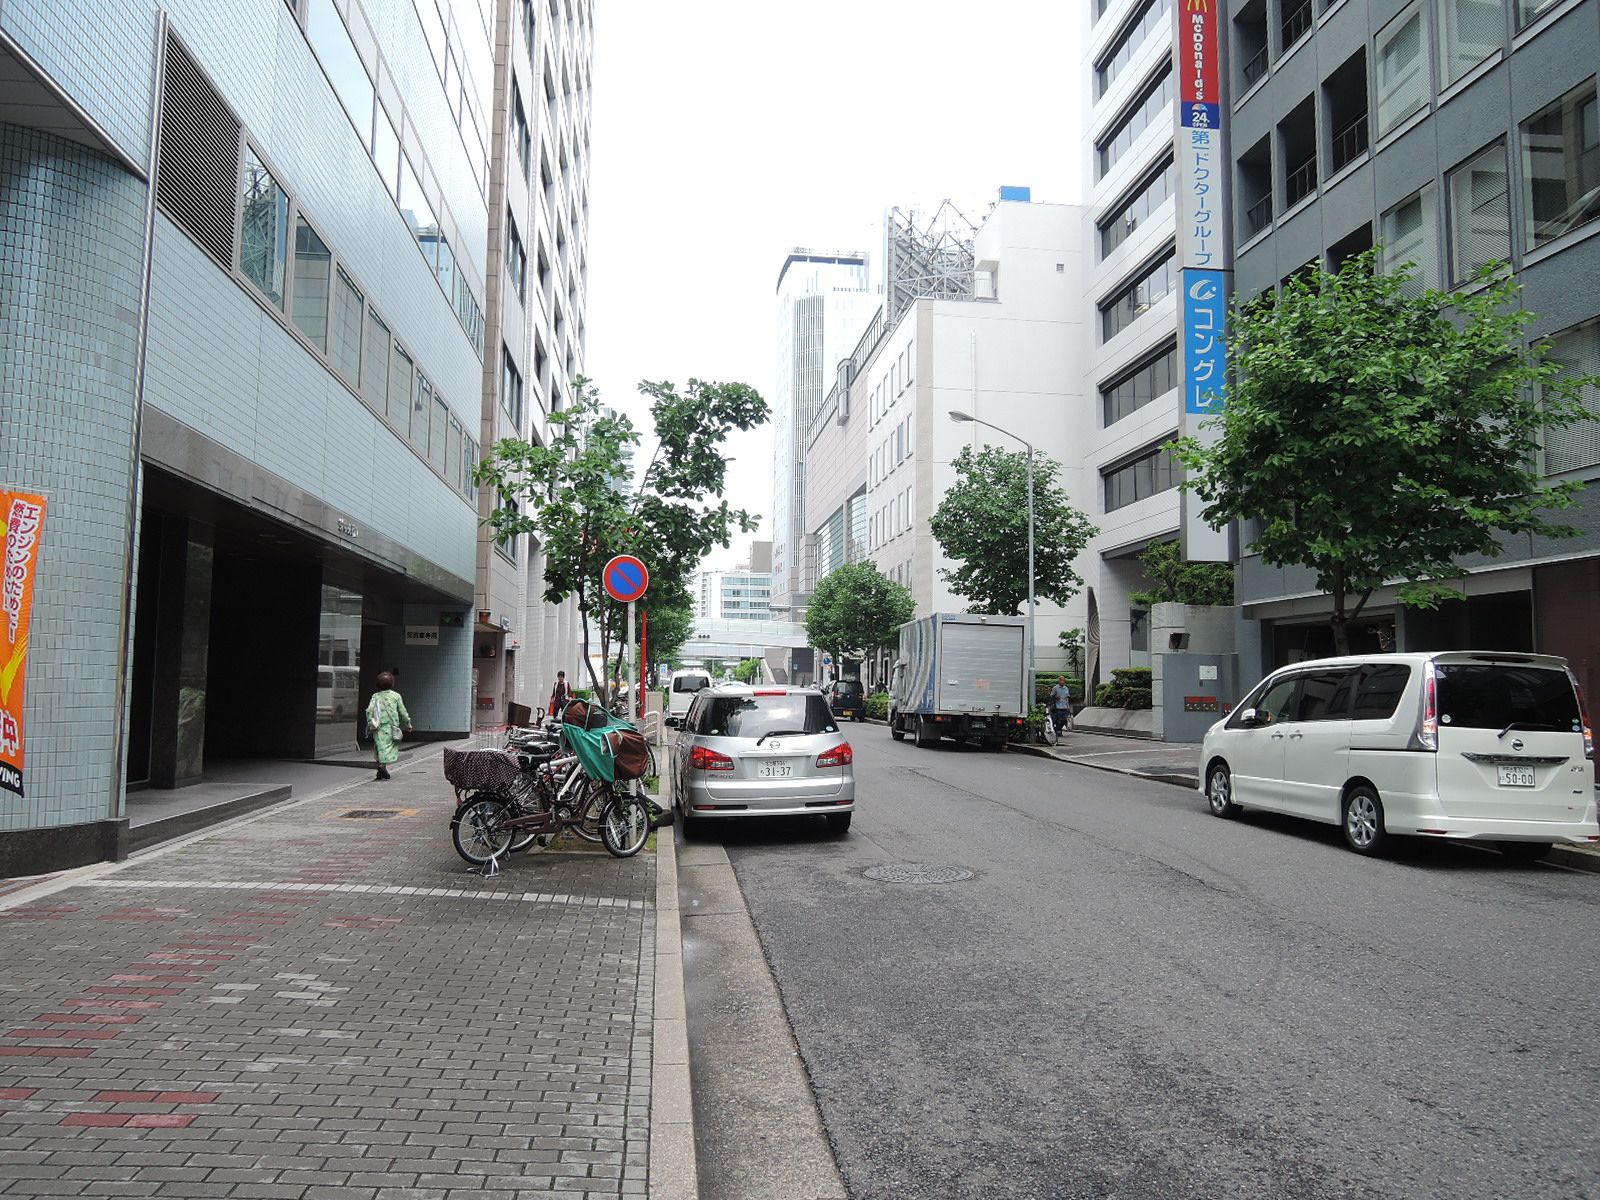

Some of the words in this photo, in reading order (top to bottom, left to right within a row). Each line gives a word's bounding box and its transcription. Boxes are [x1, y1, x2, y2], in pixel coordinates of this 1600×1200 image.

[1192, 14, 1204, 100] McDonald's
[1192, 130, 1212, 265] 第一ドクターグループ
[1194, 308, 1214, 407] コングレ
[765, 766, 791, 777] 31-37
